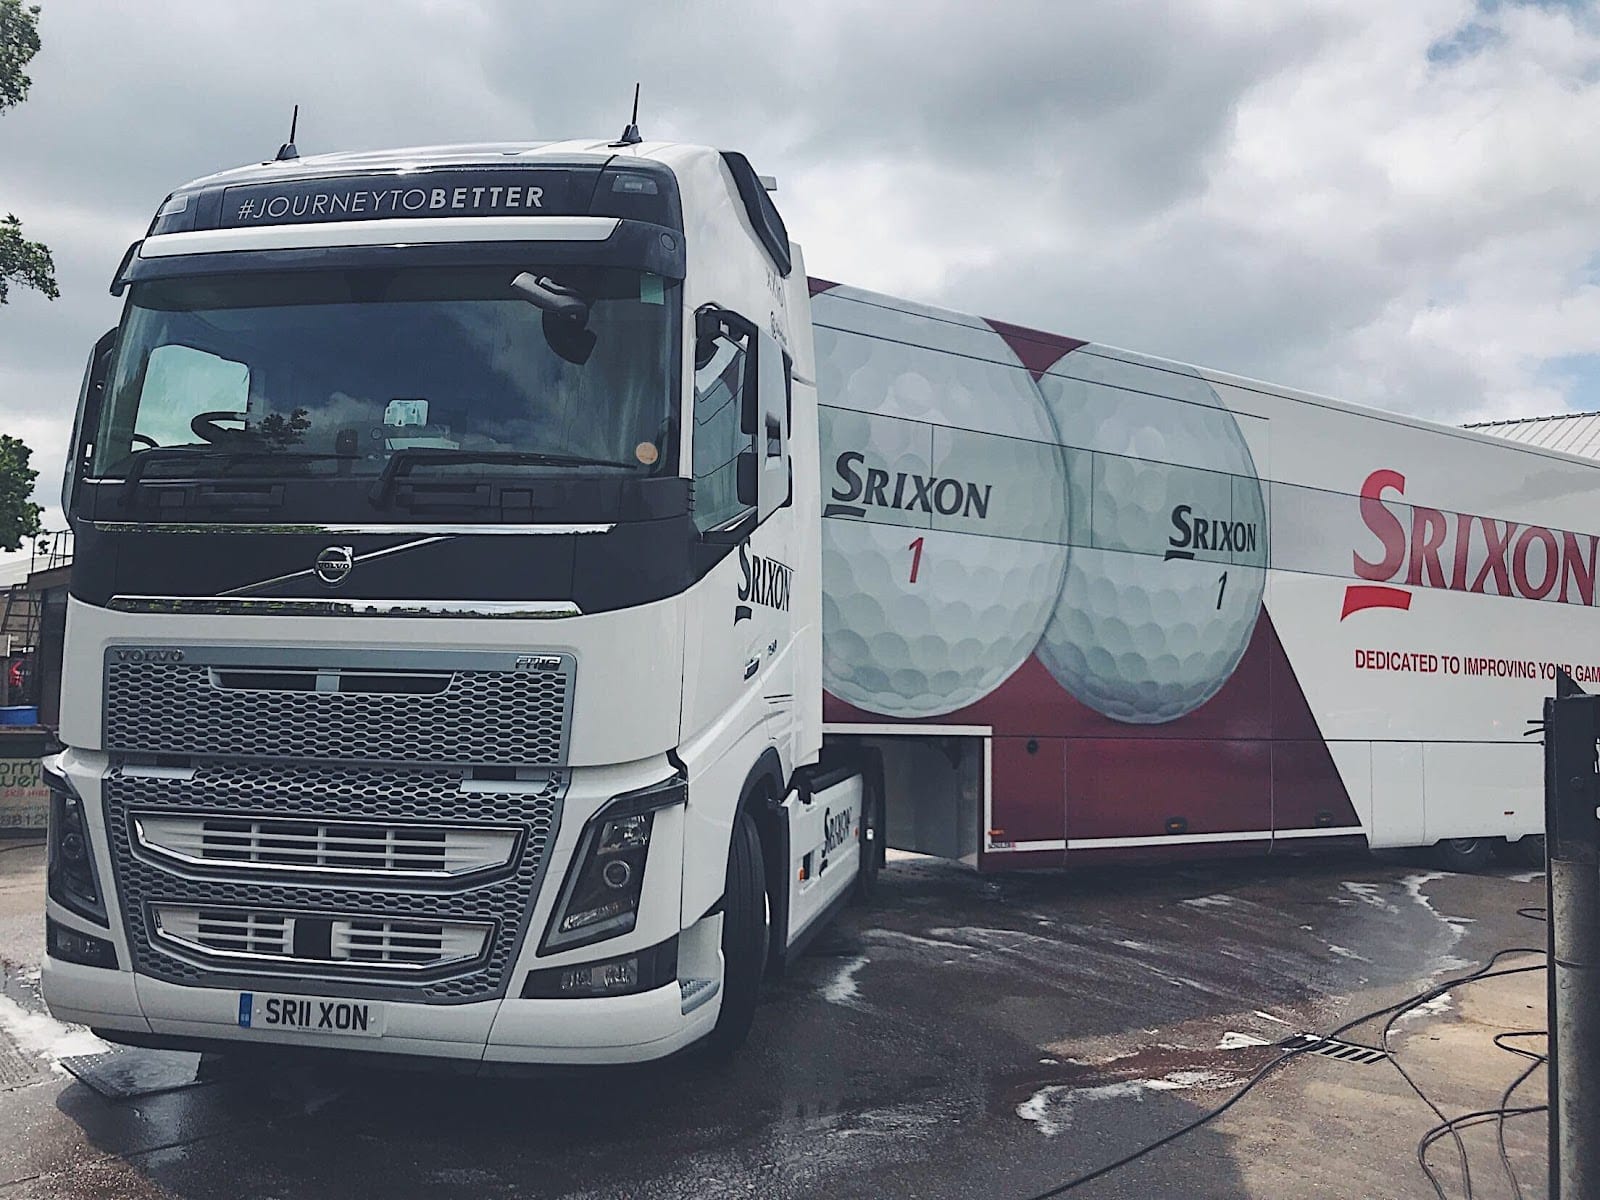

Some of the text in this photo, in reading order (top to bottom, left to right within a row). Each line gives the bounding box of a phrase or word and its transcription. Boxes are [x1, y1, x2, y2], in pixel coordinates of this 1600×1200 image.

[238, 186, 544, 220] #JOURNEYTOBETTER
[831, 451, 992, 519] SRIXON
[1168, 504, 1257, 553] SRIXON
[1353, 469, 1600, 607] SRIXON
[318, 562, 350, 570] VOLVO
[737, 536, 792, 613] SRIXON
[908, 536, 924, 584] 1
[1216, 570, 1228, 611] 1
[115, 648, 184, 662] VOLVO
[1355, 650, 1438, 673] DEDICATED
[1441, 656, 1460, 674] TO
[1463, 657, 1537, 679] IMPROVING
[318, 1001, 368, 1031] XON
